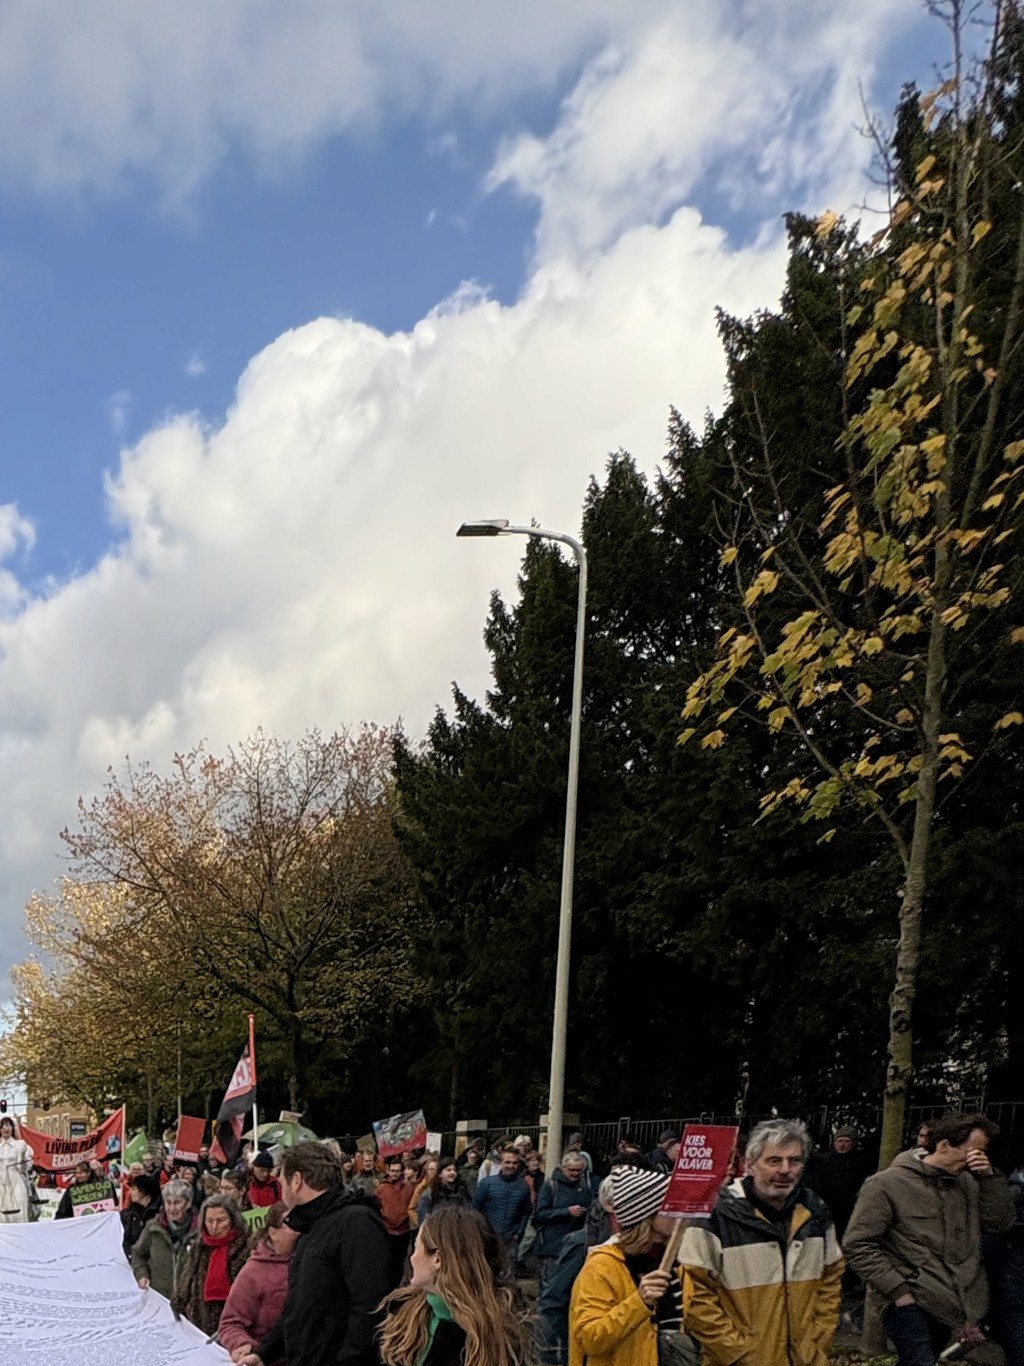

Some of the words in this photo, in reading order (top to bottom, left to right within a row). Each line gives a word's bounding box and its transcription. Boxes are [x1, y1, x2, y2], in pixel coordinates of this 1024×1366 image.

[685, 1134, 706, 1146] KIES
[45, 1141, 77, 1154] LIVING
[682, 1146, 713, 1158] VOOR
[678, 1158, 713, 1170] KLAVER
[70, 1183, 95, 1195] SAMEN
